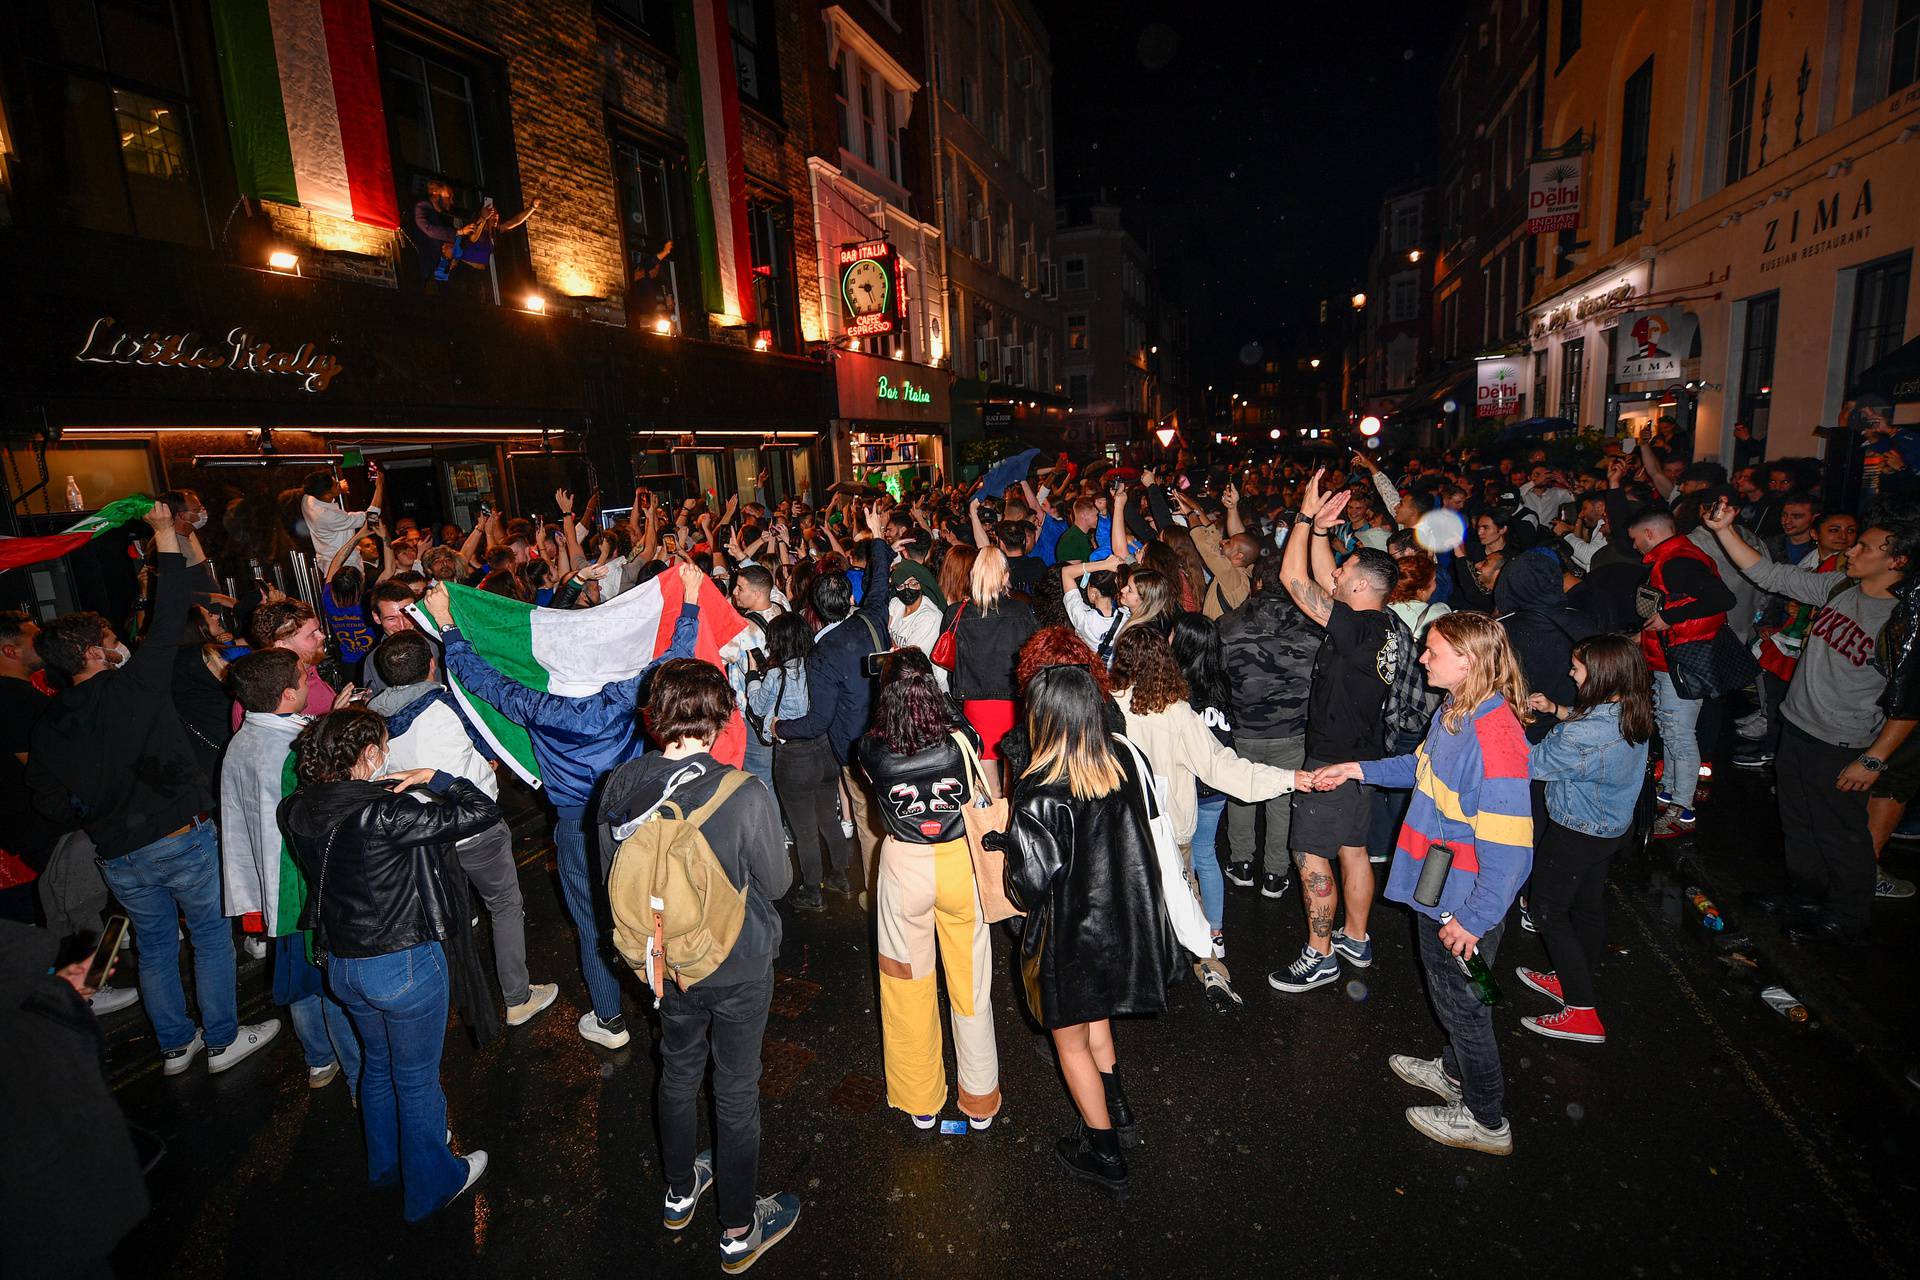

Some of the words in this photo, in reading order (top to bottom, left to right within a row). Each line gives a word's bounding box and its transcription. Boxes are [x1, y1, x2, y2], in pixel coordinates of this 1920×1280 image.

[1531, 185, 1579, 209] Delhi
[1531, 214, 1576, 226] INDIAN
[1762, 179, 1872, 254] ZIMA
[1531, 222, 1575, 233] CUISINE
[841, 249, 857, 263] BAR
[858, 243, 887, 259] ITALIA
[1760, 252, 1797, 273] RUSSIAN
[1802, 225, 1872, 259] RESTAURANT
[847, 321, 890, 336] ESPRESSO
[76, 317, 225, 369] Little
[227, 326, 343, 392] Italy
[1623, 361, 1674, 374] ZIMA
[878, 375, 899, 400] Bar
[903, 380, 931, 403] Italia
[1479, 382, 1517, 400] Delhi
